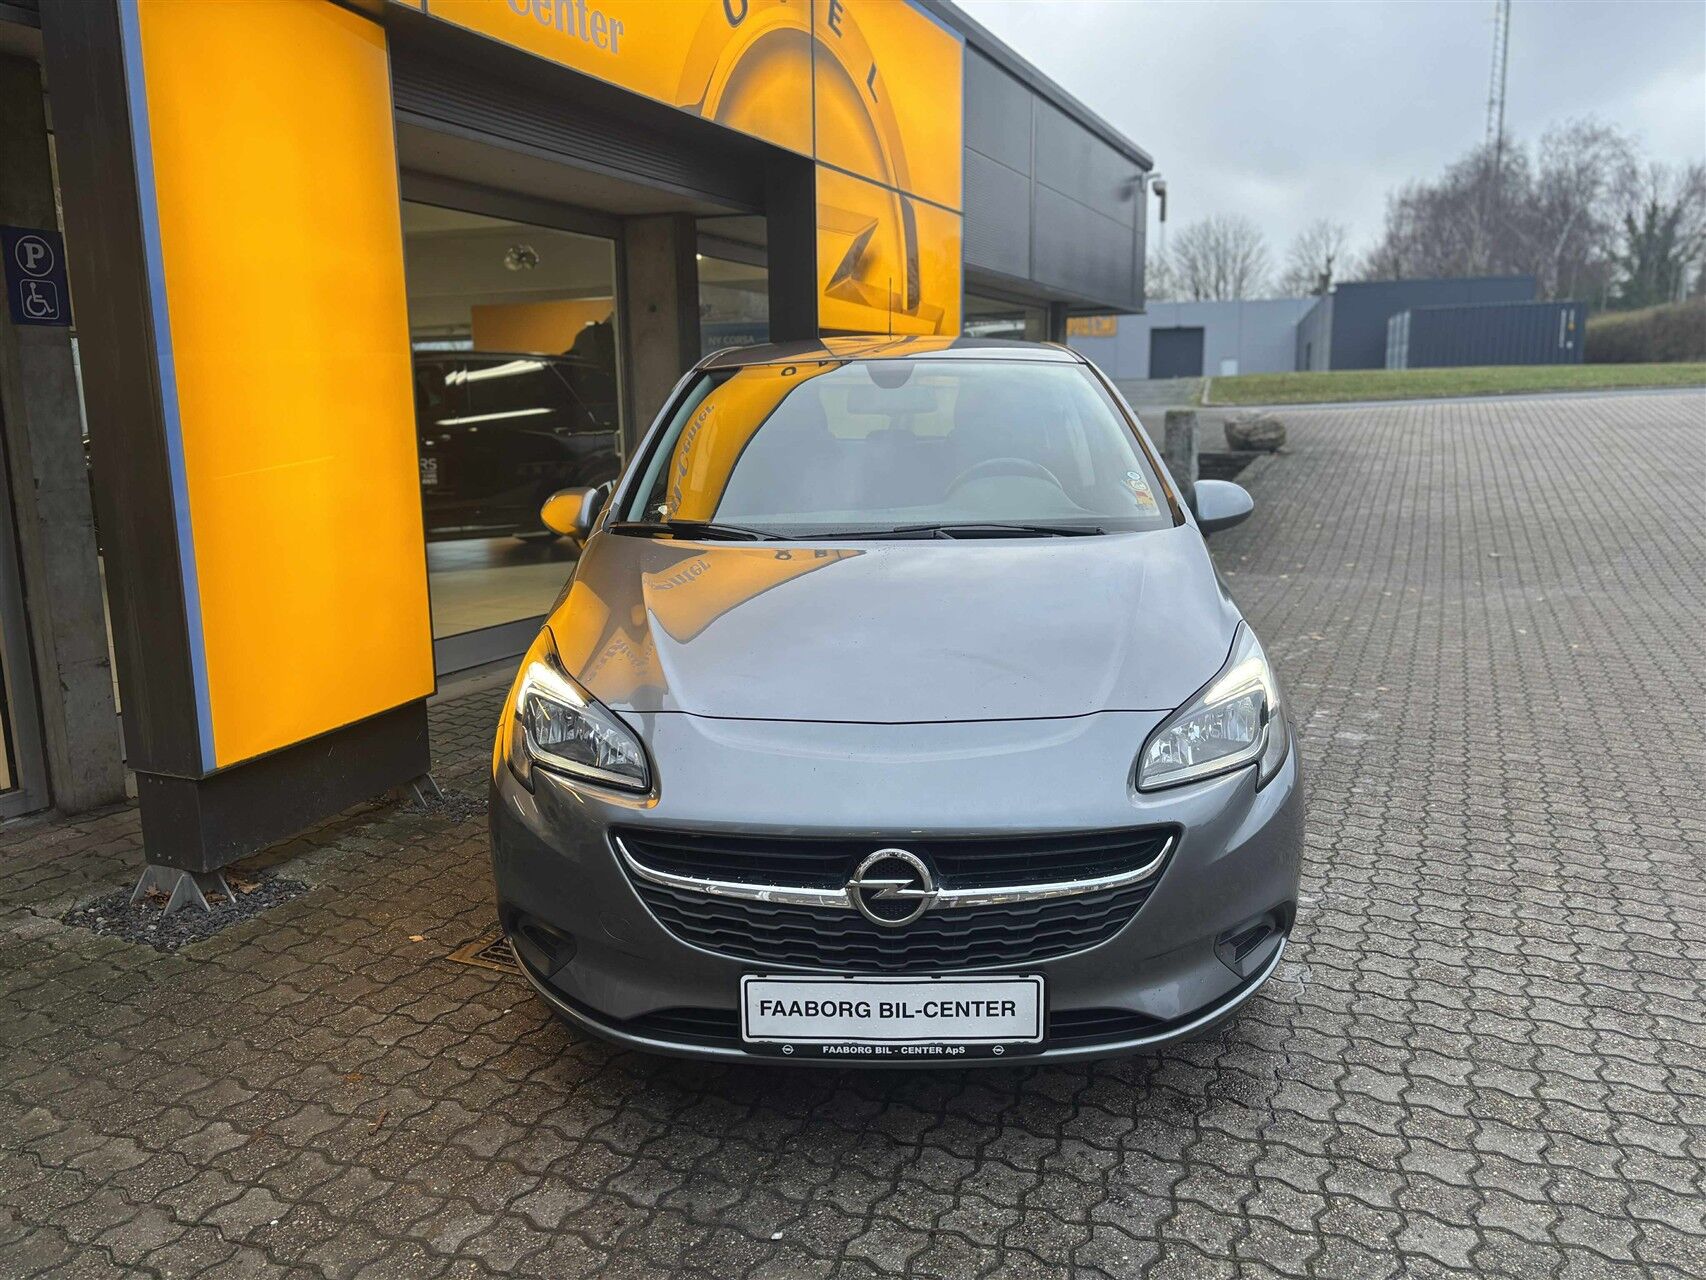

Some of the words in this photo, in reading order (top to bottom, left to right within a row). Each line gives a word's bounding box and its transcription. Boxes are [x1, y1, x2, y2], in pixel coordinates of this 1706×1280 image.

[24, 243, 44, 269] P
[760, 1000, 871, 1018] FAABORG
[879, 1000, 1016, 1019] BIL-CENTER
[823, 1046, 872, 1055] FAABORG
[875, 1047, 892, 1055] BIL
[901, 1046, 943, 1055] CENTER
[945, 1046, 966, 1056] ApS
